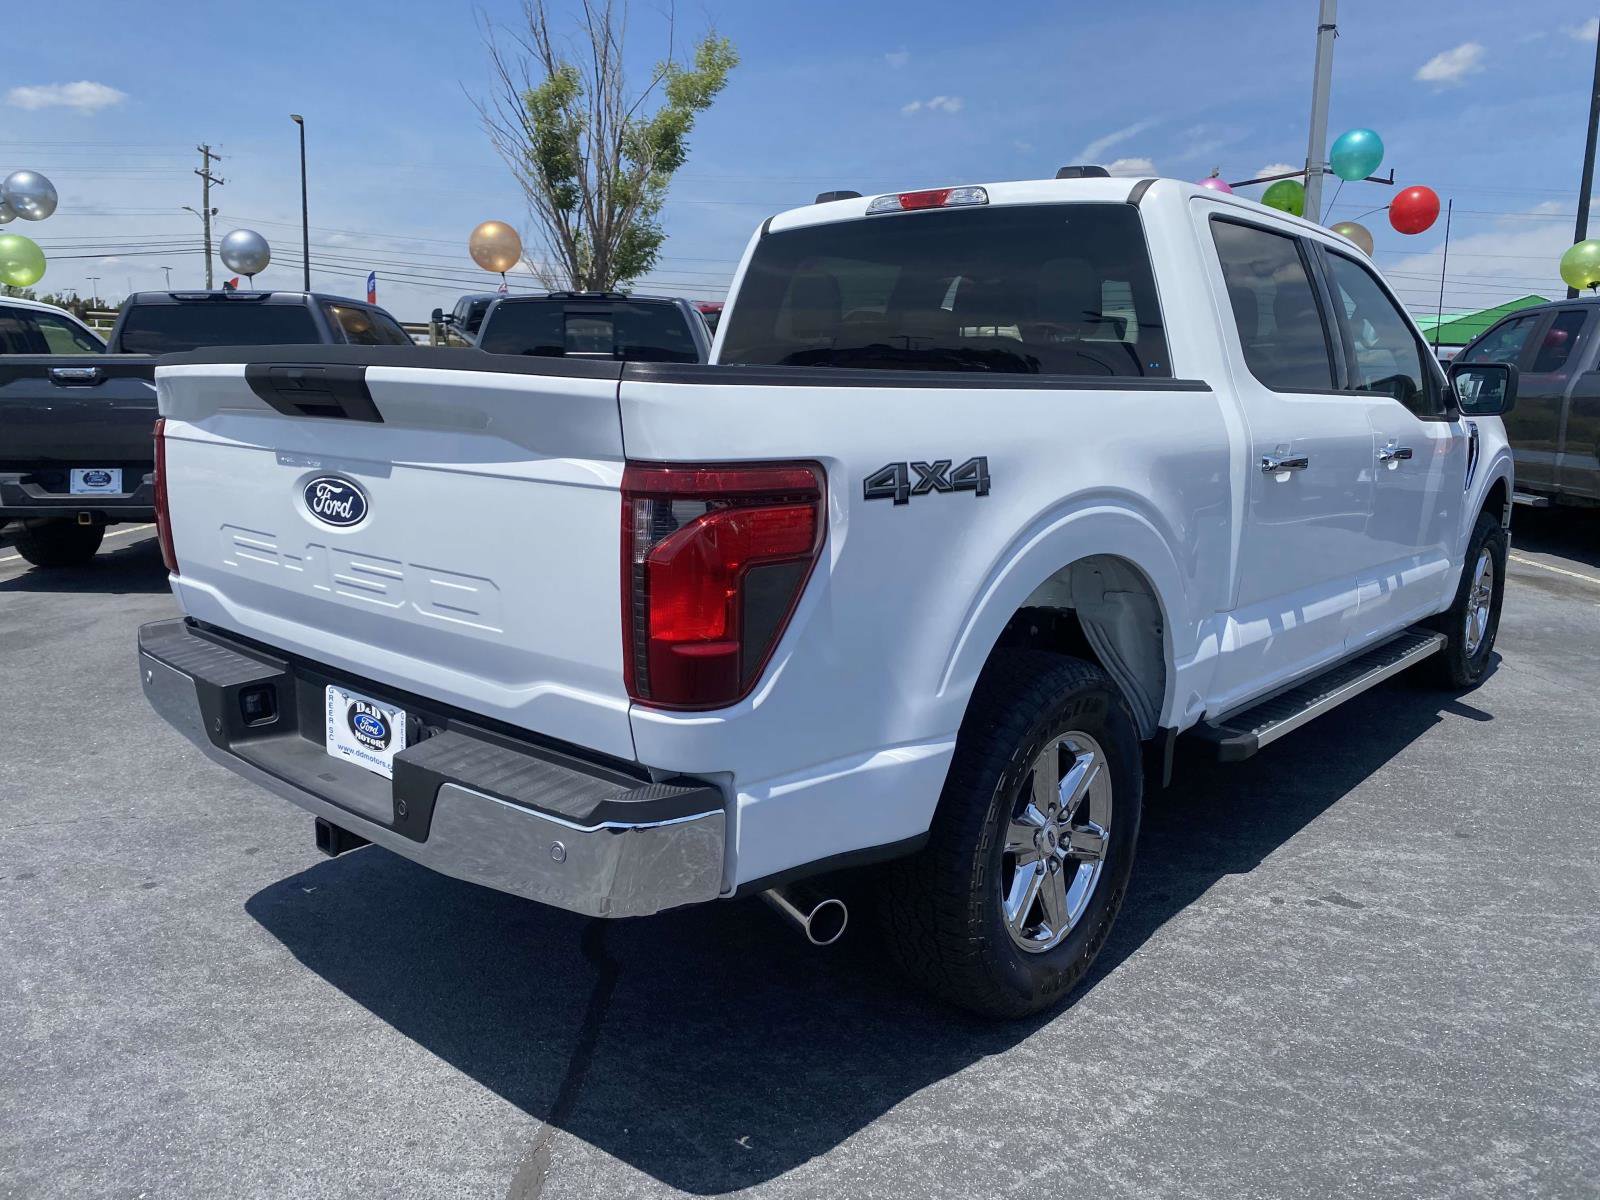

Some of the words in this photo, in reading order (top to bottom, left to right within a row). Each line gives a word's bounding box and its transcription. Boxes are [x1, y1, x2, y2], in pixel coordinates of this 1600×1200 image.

[313, 483, 353, 518] Ford
[220, 523, 503, 633] F-150
[356, 702, 381, 719] D&D
[328, 726, 335, 741] SC
[360, 716, 379, 735] Ford
[355, 729, 385, 750] MOTORS
[337, 743, 393, 770] www.ddmotors.c
